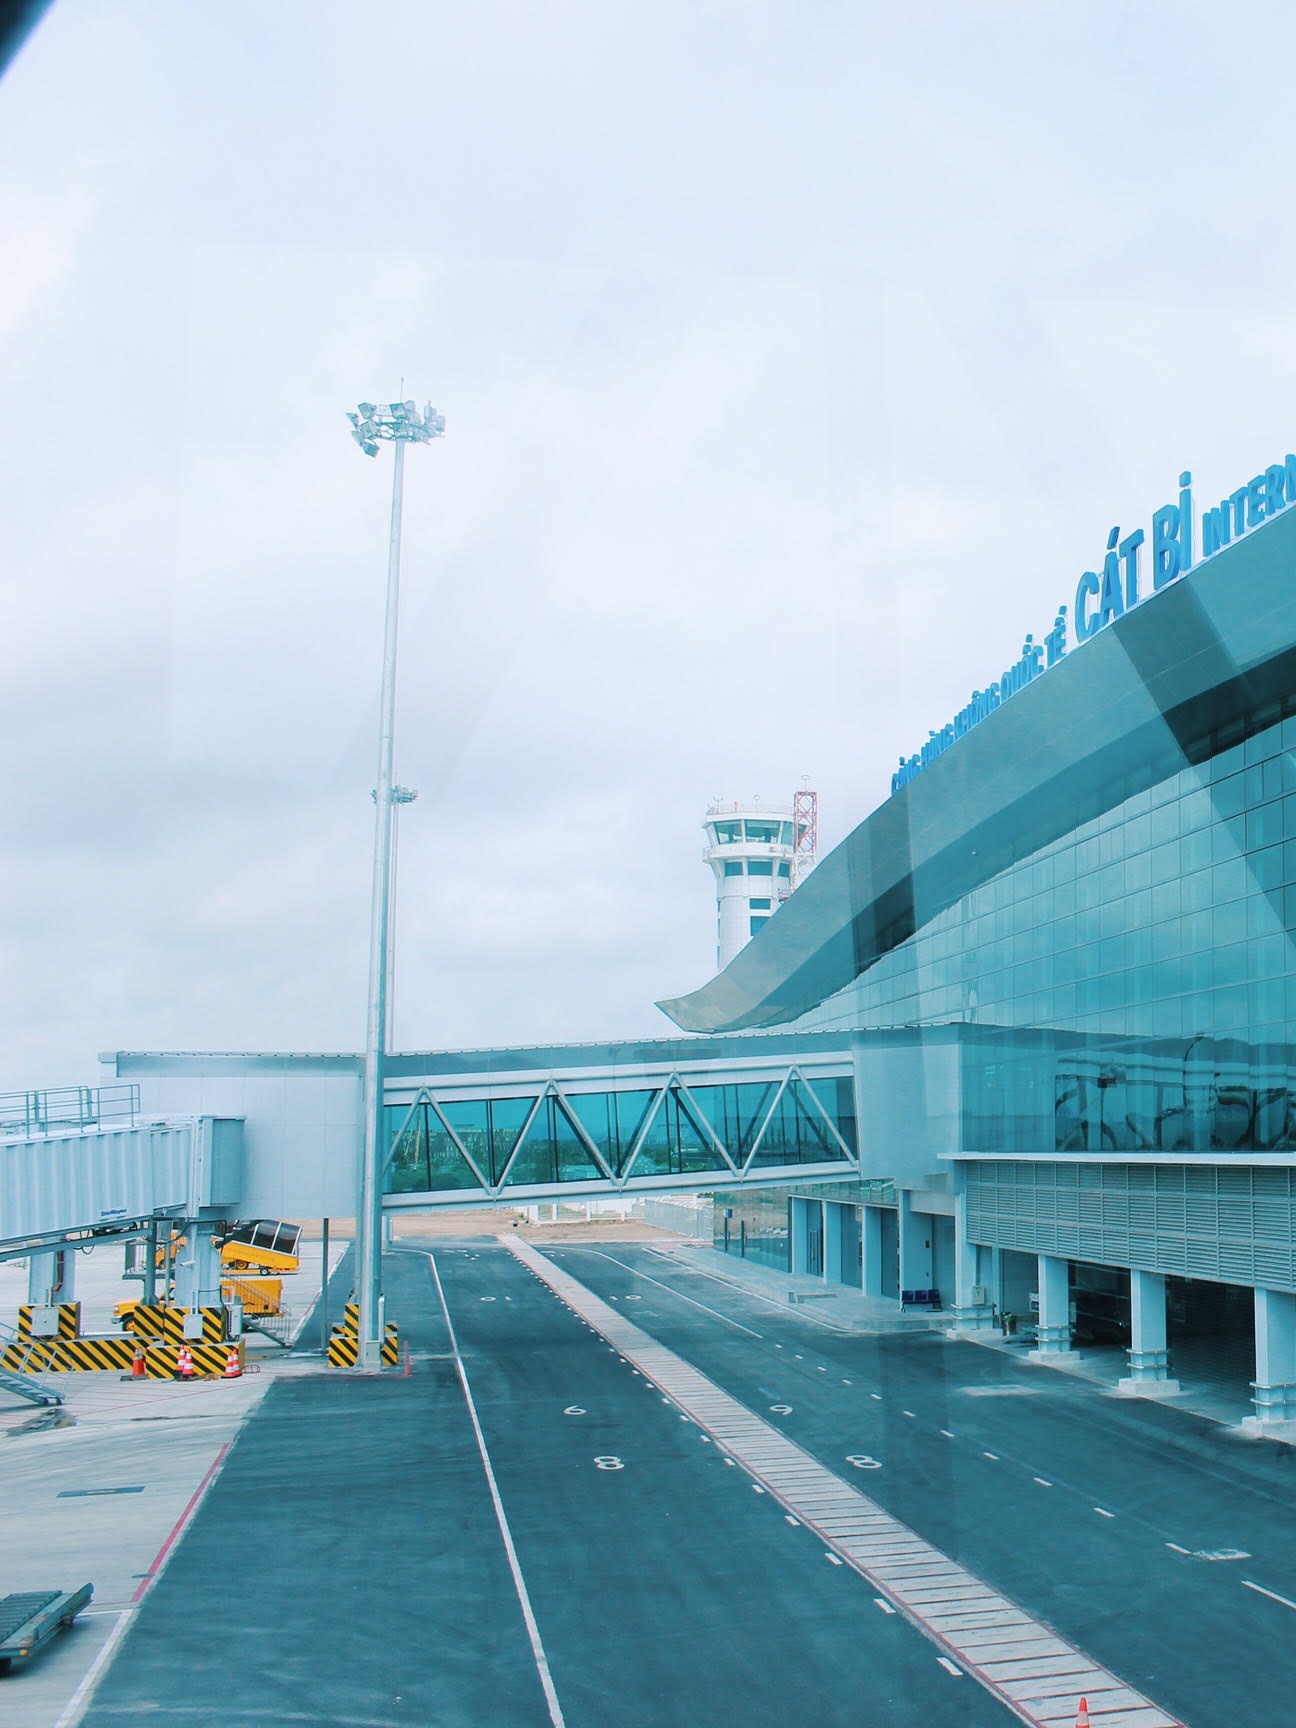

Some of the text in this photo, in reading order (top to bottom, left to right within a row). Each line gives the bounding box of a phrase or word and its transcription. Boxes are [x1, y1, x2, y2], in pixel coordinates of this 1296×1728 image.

[1074, 526, 1144, 644] CÁT
[769, 1404, 793, 1416] 9
[593, 1455, 625, 1470] 8
[845, 1454, 882, 1469] 8
